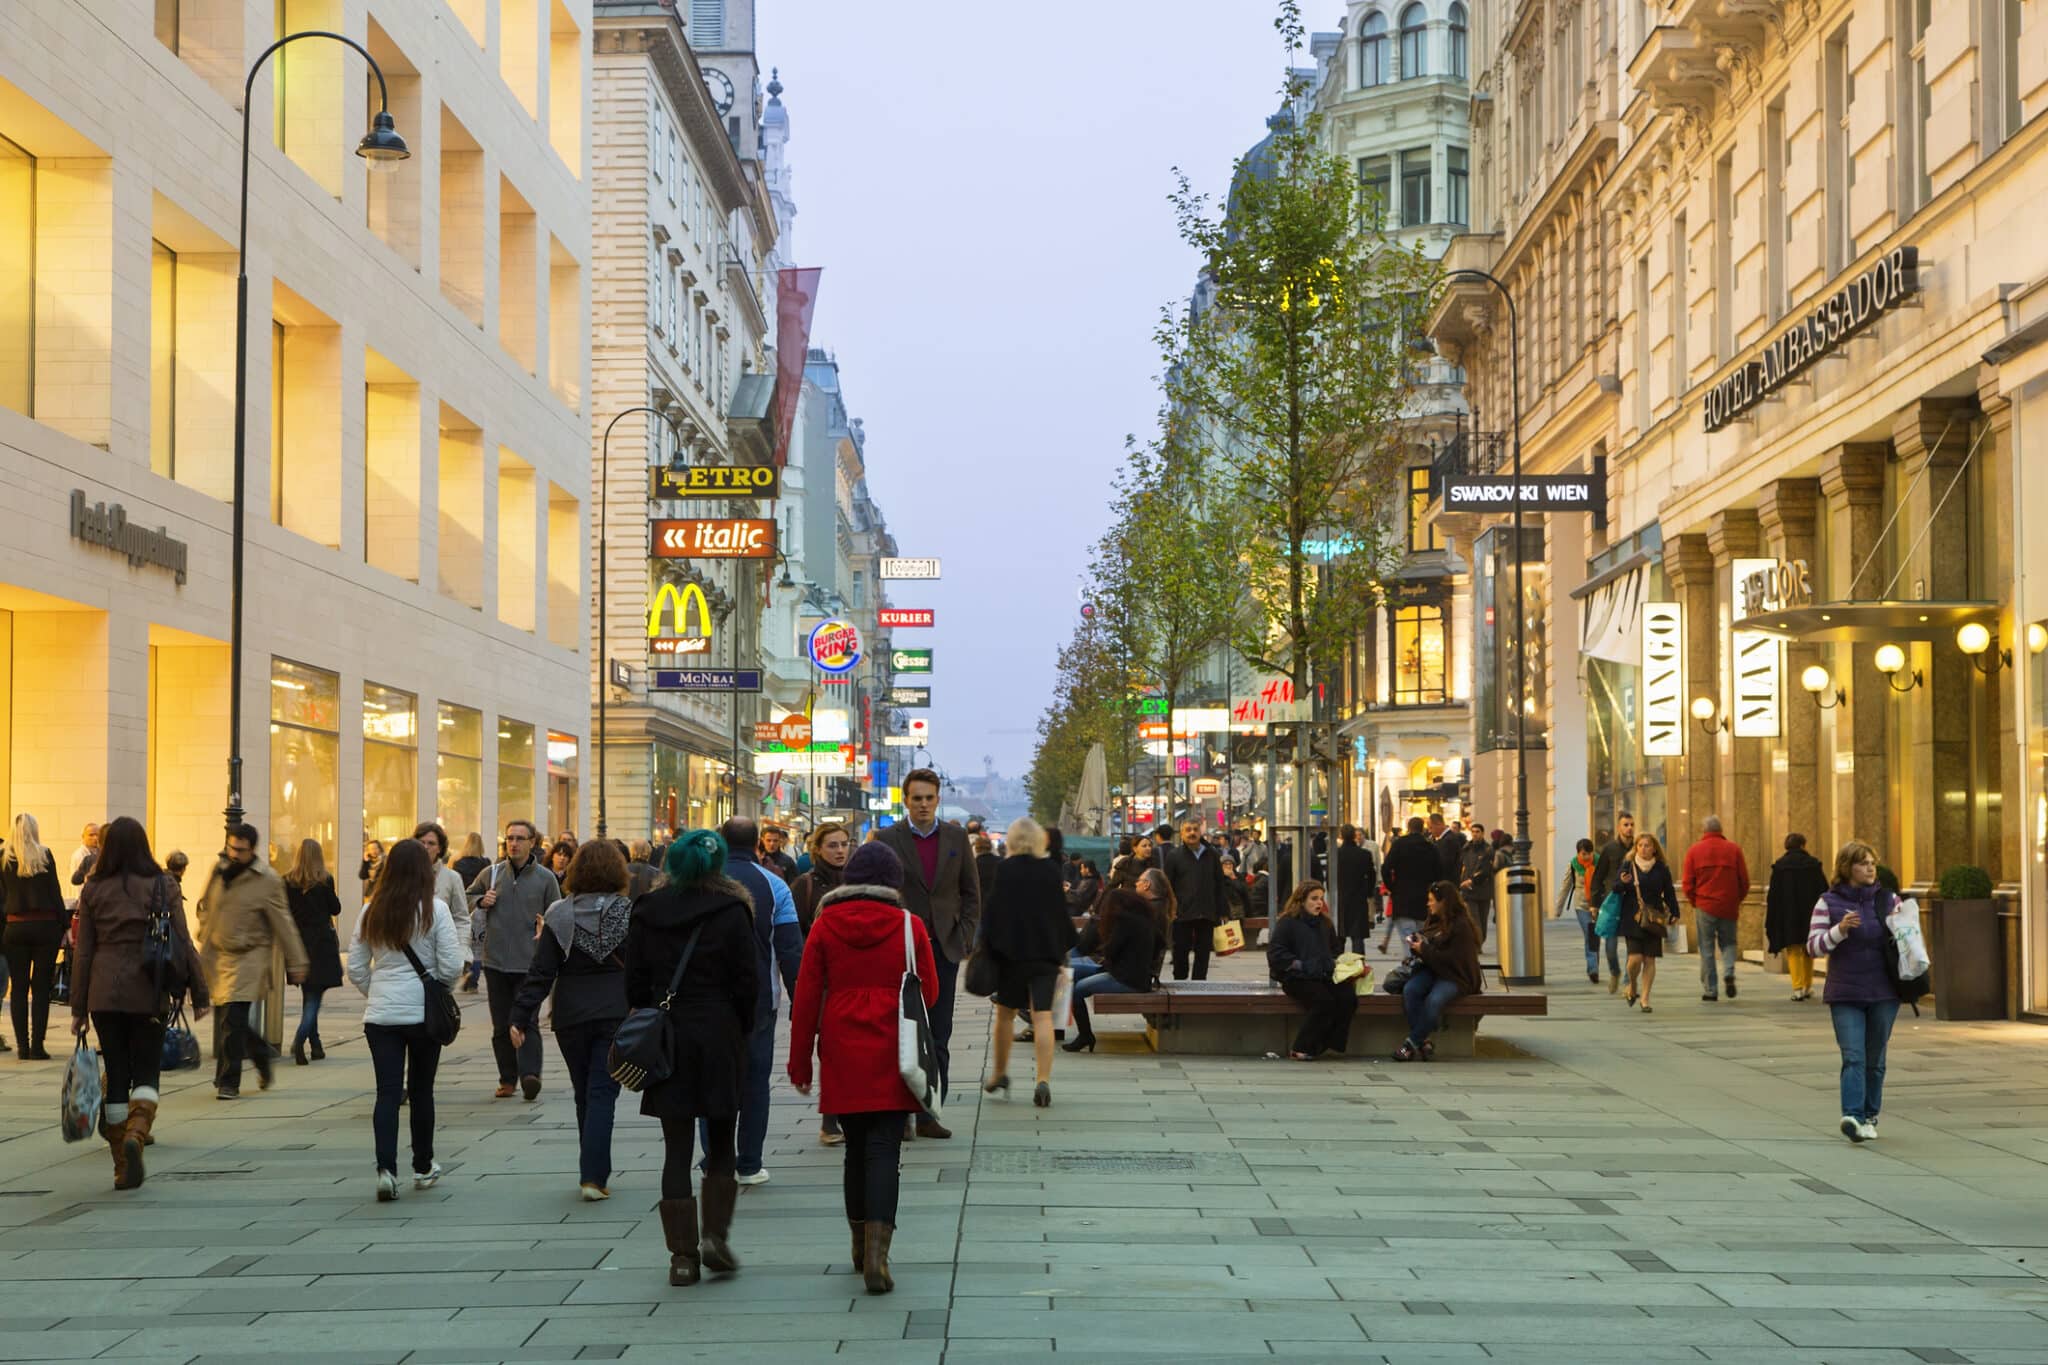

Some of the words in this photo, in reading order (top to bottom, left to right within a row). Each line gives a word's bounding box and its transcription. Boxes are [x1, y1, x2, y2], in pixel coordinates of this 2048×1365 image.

[1703, 363, 1753, 432] HOTEL
[1757, 247, 1905, 395] AMBASSADOR
[1545, 485, 1589, 501] WIEN
[694, 522, 764, 549] italic
[881, 612, 932, 623] KURIER
[814, 627, 857, 649] BURGER
[816, 637, 858, 662] KING
[1649, 613, 1676, 743] MANGO
